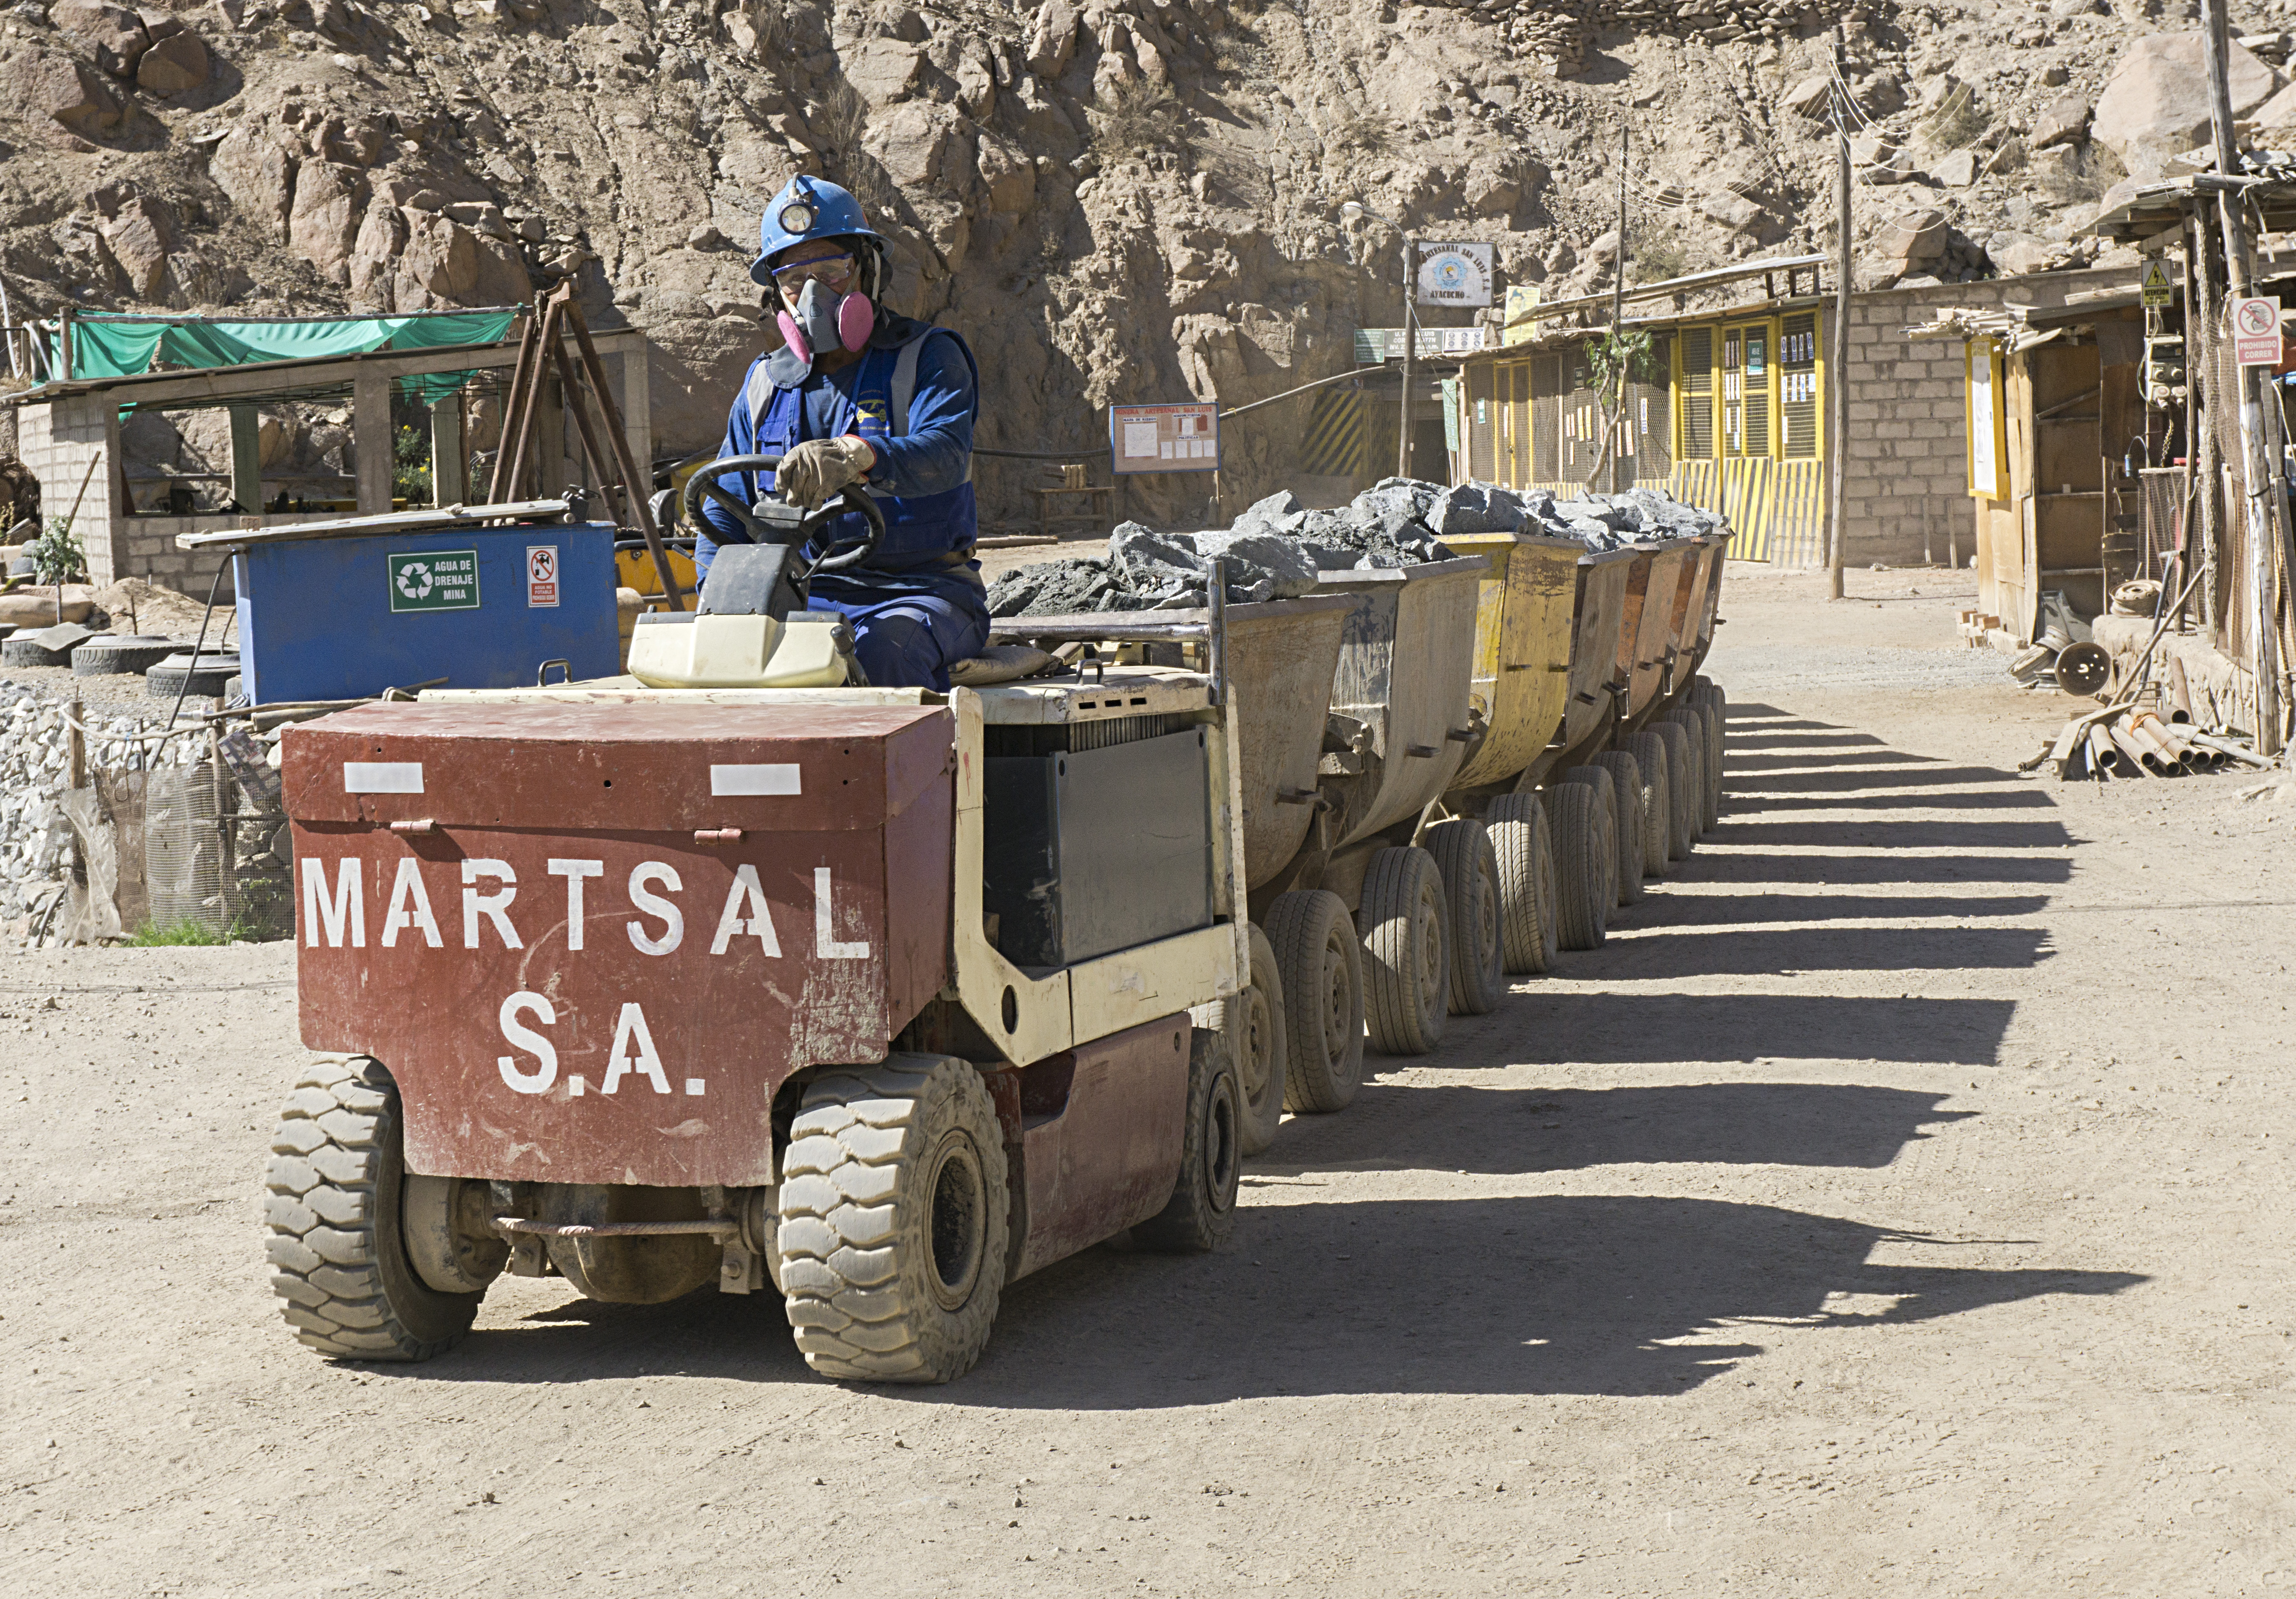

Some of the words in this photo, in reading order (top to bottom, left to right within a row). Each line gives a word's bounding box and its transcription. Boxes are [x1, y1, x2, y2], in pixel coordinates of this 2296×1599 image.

[1461, 248, 1474, 259] SAN
[1473, 258, 1487, 274] LUIS
[1430, 290, 1465, 299] AYACUCHO
[2239, 340, 2277, 350] PROHIBIDO
[2244, 349, 2273, 359] CORRER
[435, 561, 458, 572] AGUA
[460, 560, 471, 570] DE
[435, 574, 473, 586] DRENAJE
[443, 589, 466, 600] MINA
[301, 857, 870, 960] MARTSAL
[498, 991, 706, 1095] S.A.
